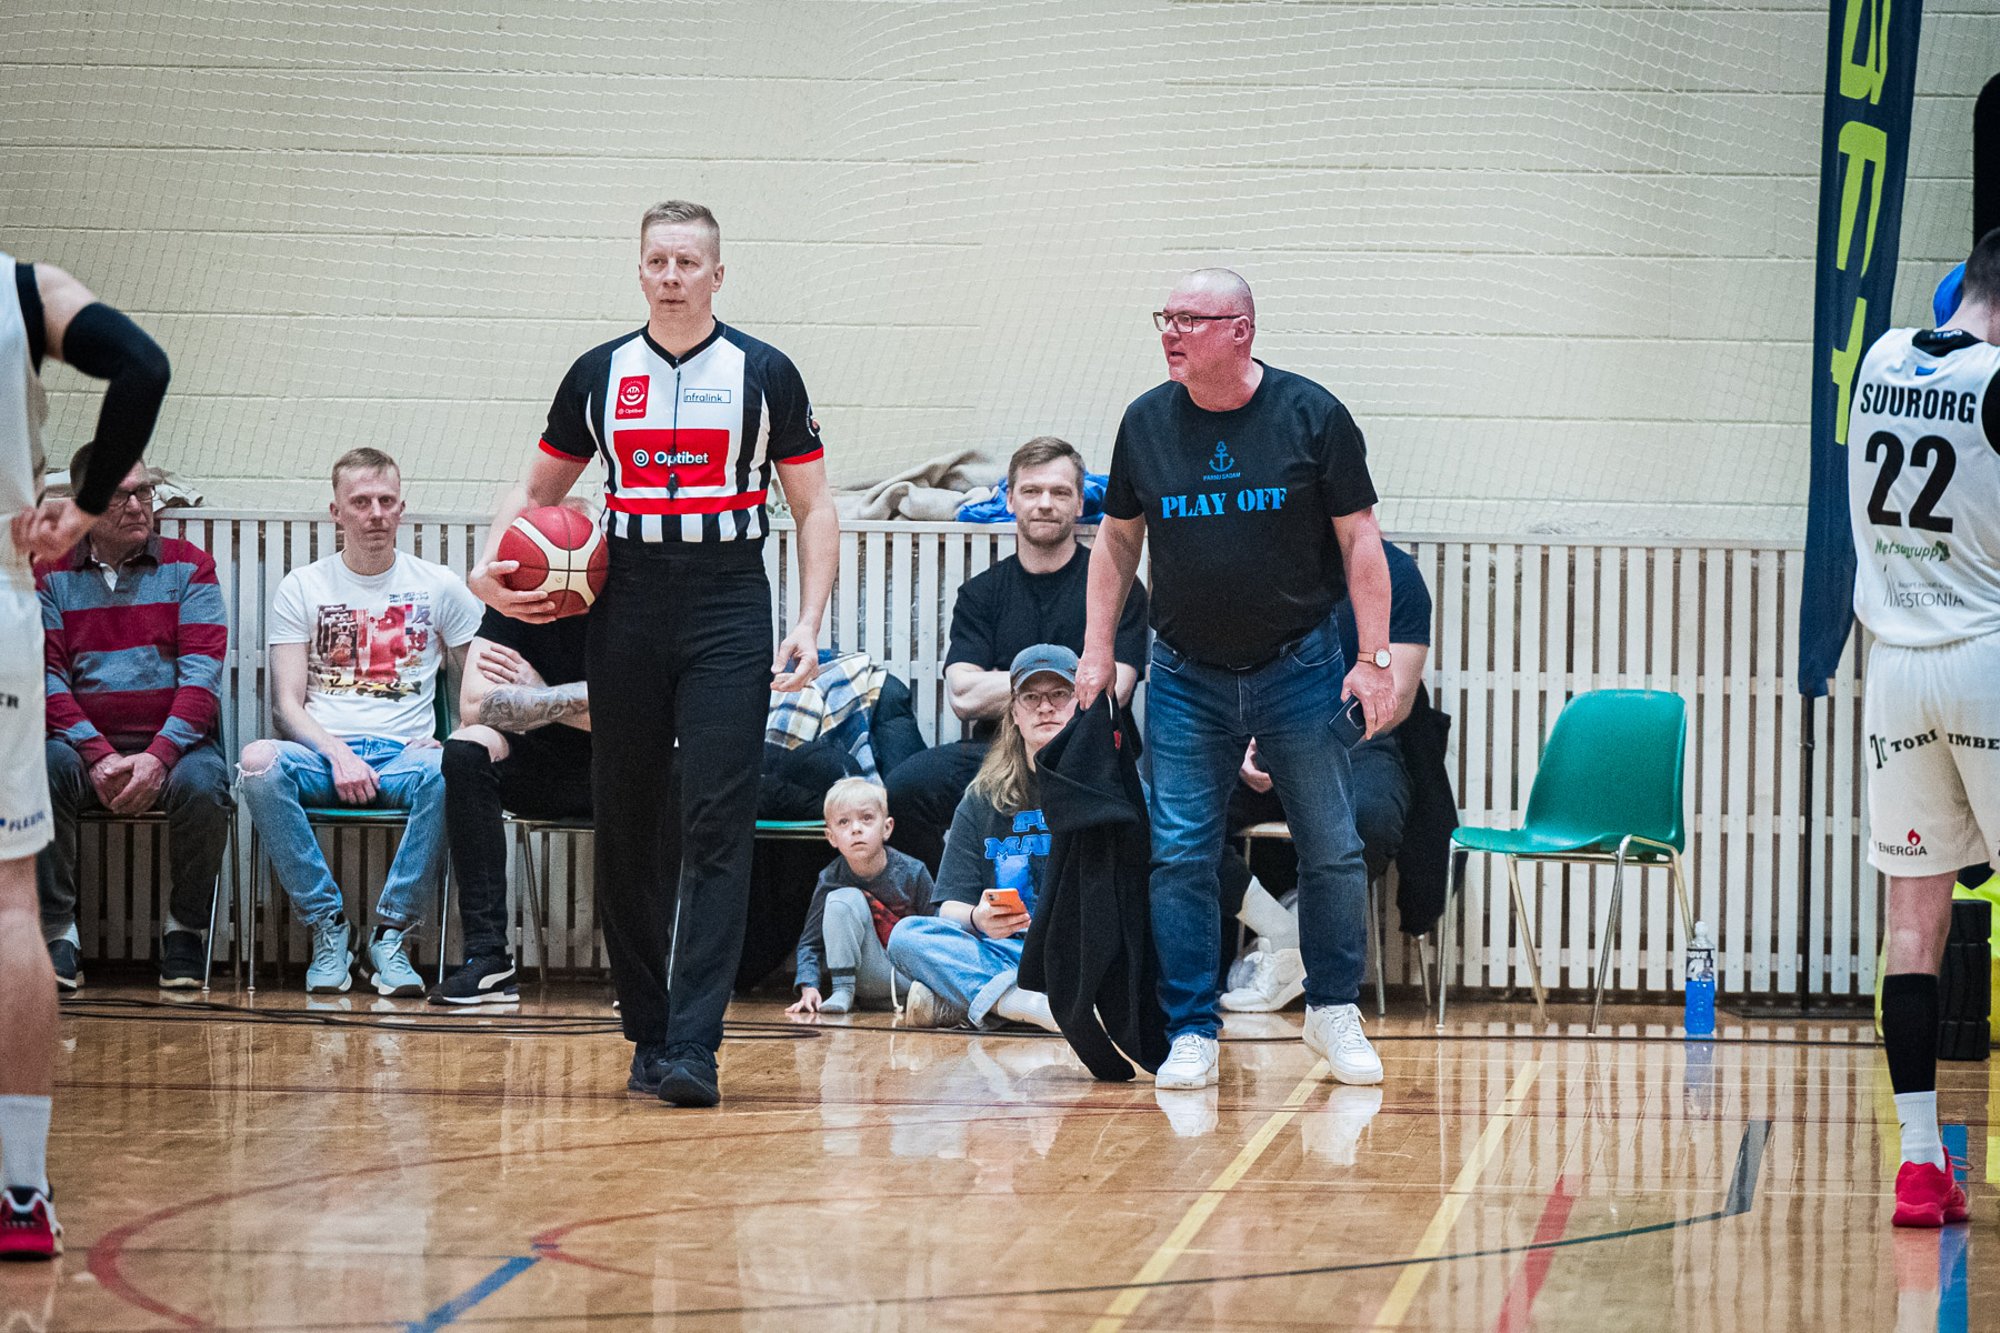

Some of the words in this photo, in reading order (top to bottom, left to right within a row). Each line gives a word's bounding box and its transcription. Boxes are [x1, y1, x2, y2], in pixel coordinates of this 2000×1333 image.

[1860, 383, 1977, 424] SUURORG
[654, 451, 709, 467] Optibet
[1865, 430, 1957, 533] 22
[1161, 492, 1227, 519] PLAY
[1237, 487, 1287, 512] OFF
[1900, 590, 1965, 608] ESTONIA
[1891, 728, 1938, 752] TORI
[1948, 732, 2000, 750] IMBE
